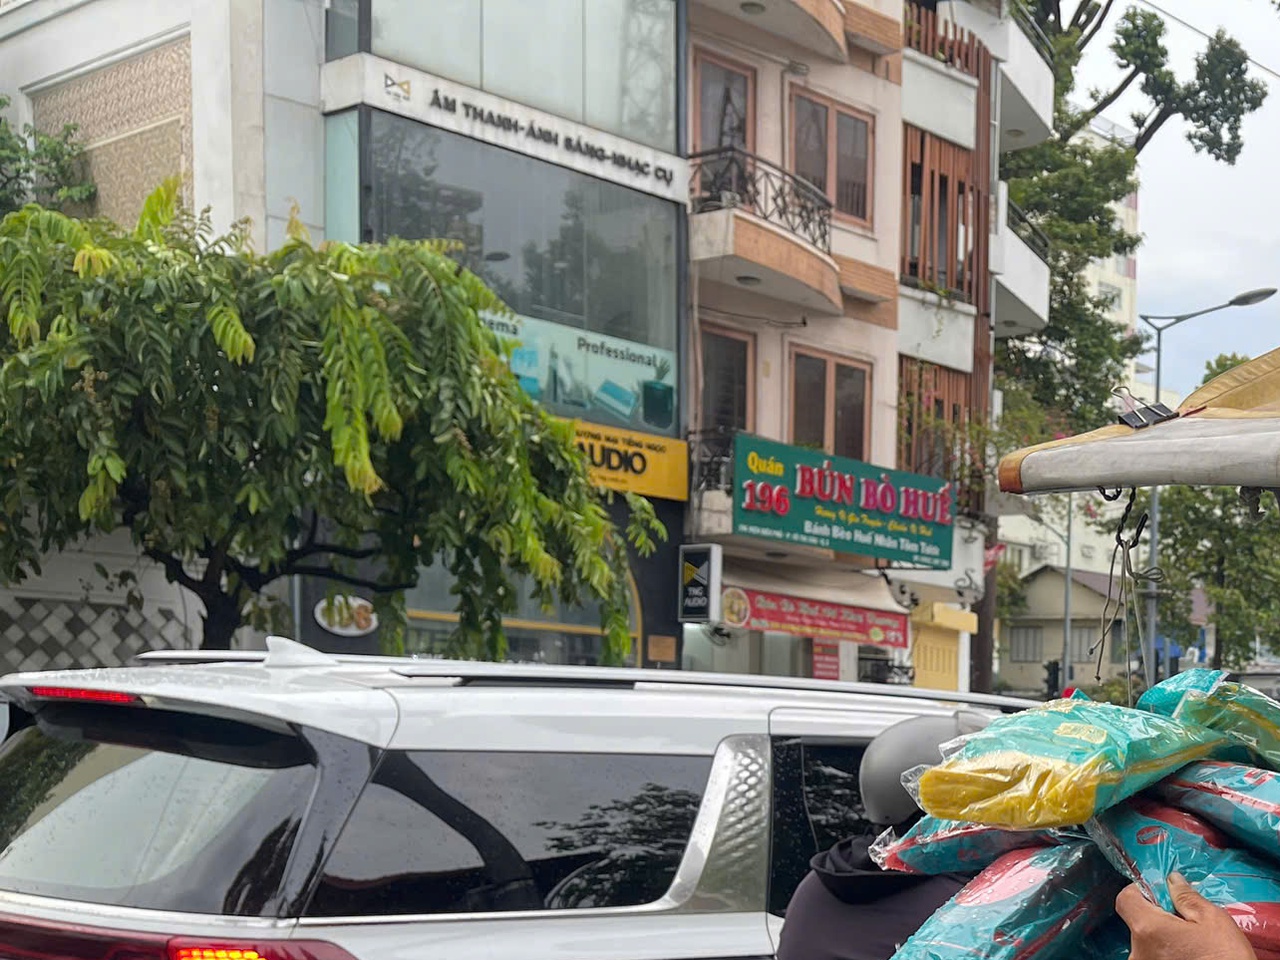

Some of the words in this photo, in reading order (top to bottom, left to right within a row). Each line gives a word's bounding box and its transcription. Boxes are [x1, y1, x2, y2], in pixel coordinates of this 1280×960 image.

[576, 336, 657, 367] Professional
[747, 451, 785, 477] Quán
[742, 479, 790, 516] 196
[795, 460, 856, 506] BÚN
[860, 473, 898, 514] BÒ
[900, 482, 954, 526] HUẾ
[804, 519, 831, 537] Bánh
[832, 525, 853, 540] Bèo
[684, 596, 708, 608] AUDIO
[687, 586, 704, 596] TNG
